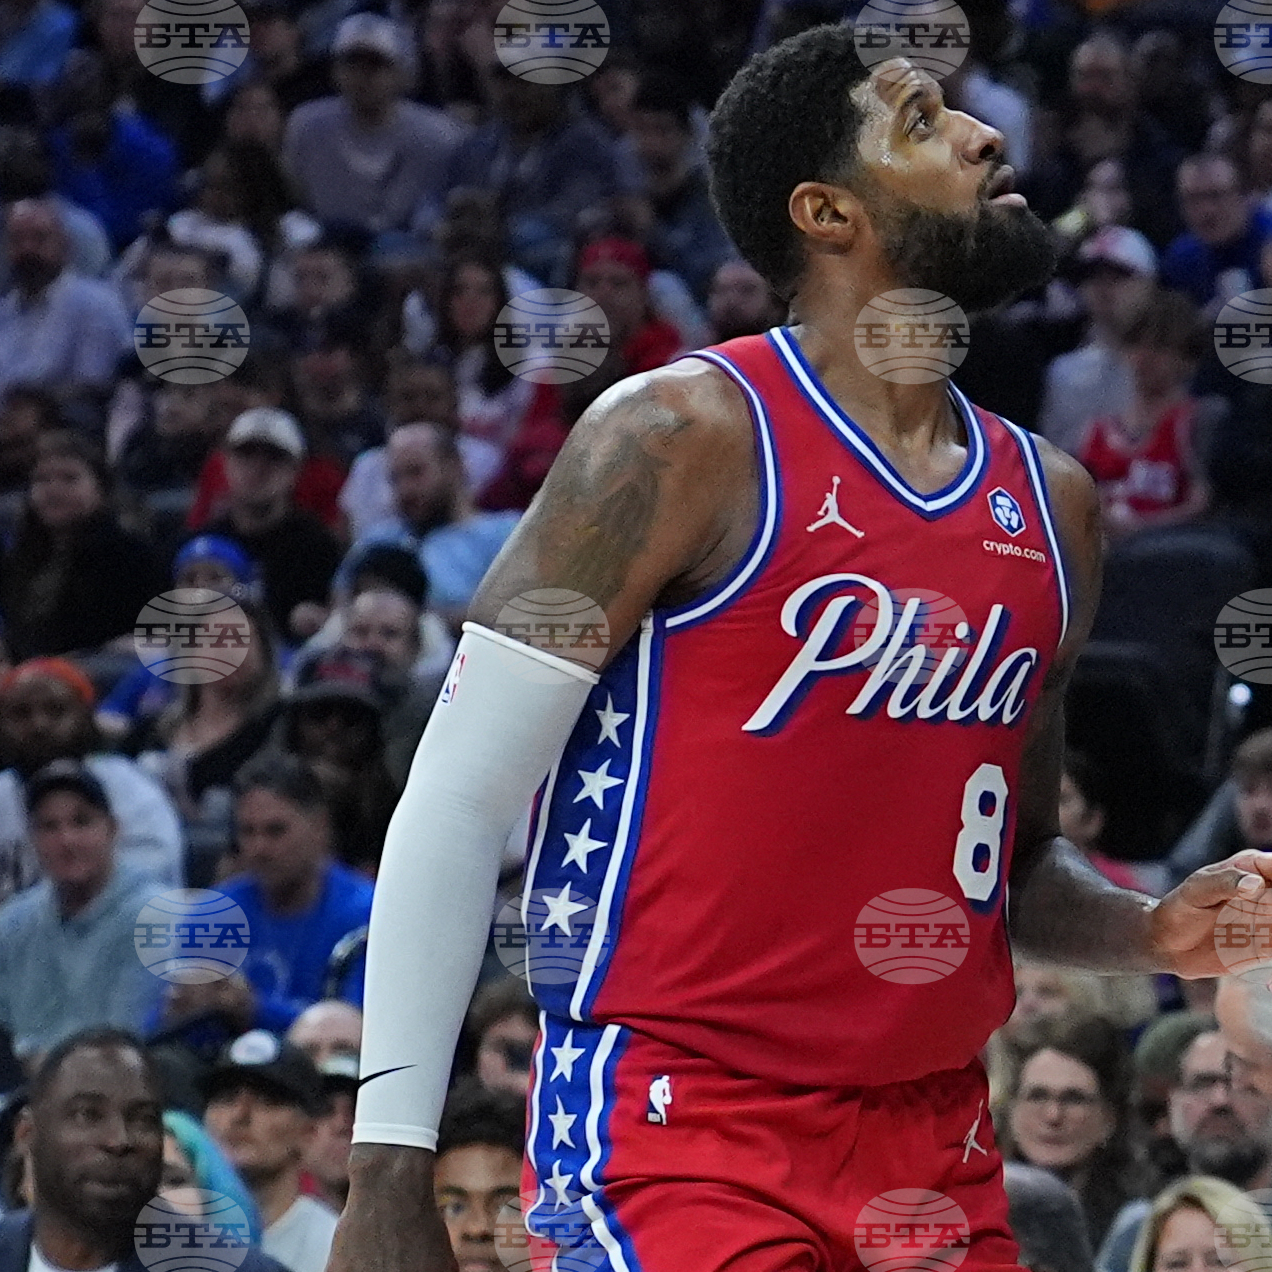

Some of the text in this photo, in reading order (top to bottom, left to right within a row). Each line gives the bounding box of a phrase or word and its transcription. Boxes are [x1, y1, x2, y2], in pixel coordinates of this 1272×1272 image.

[982, 539, 1046, 563] crypto.com
[741, 572, 1039, 733] Phila
[953, 762, 1010, 903] 8
